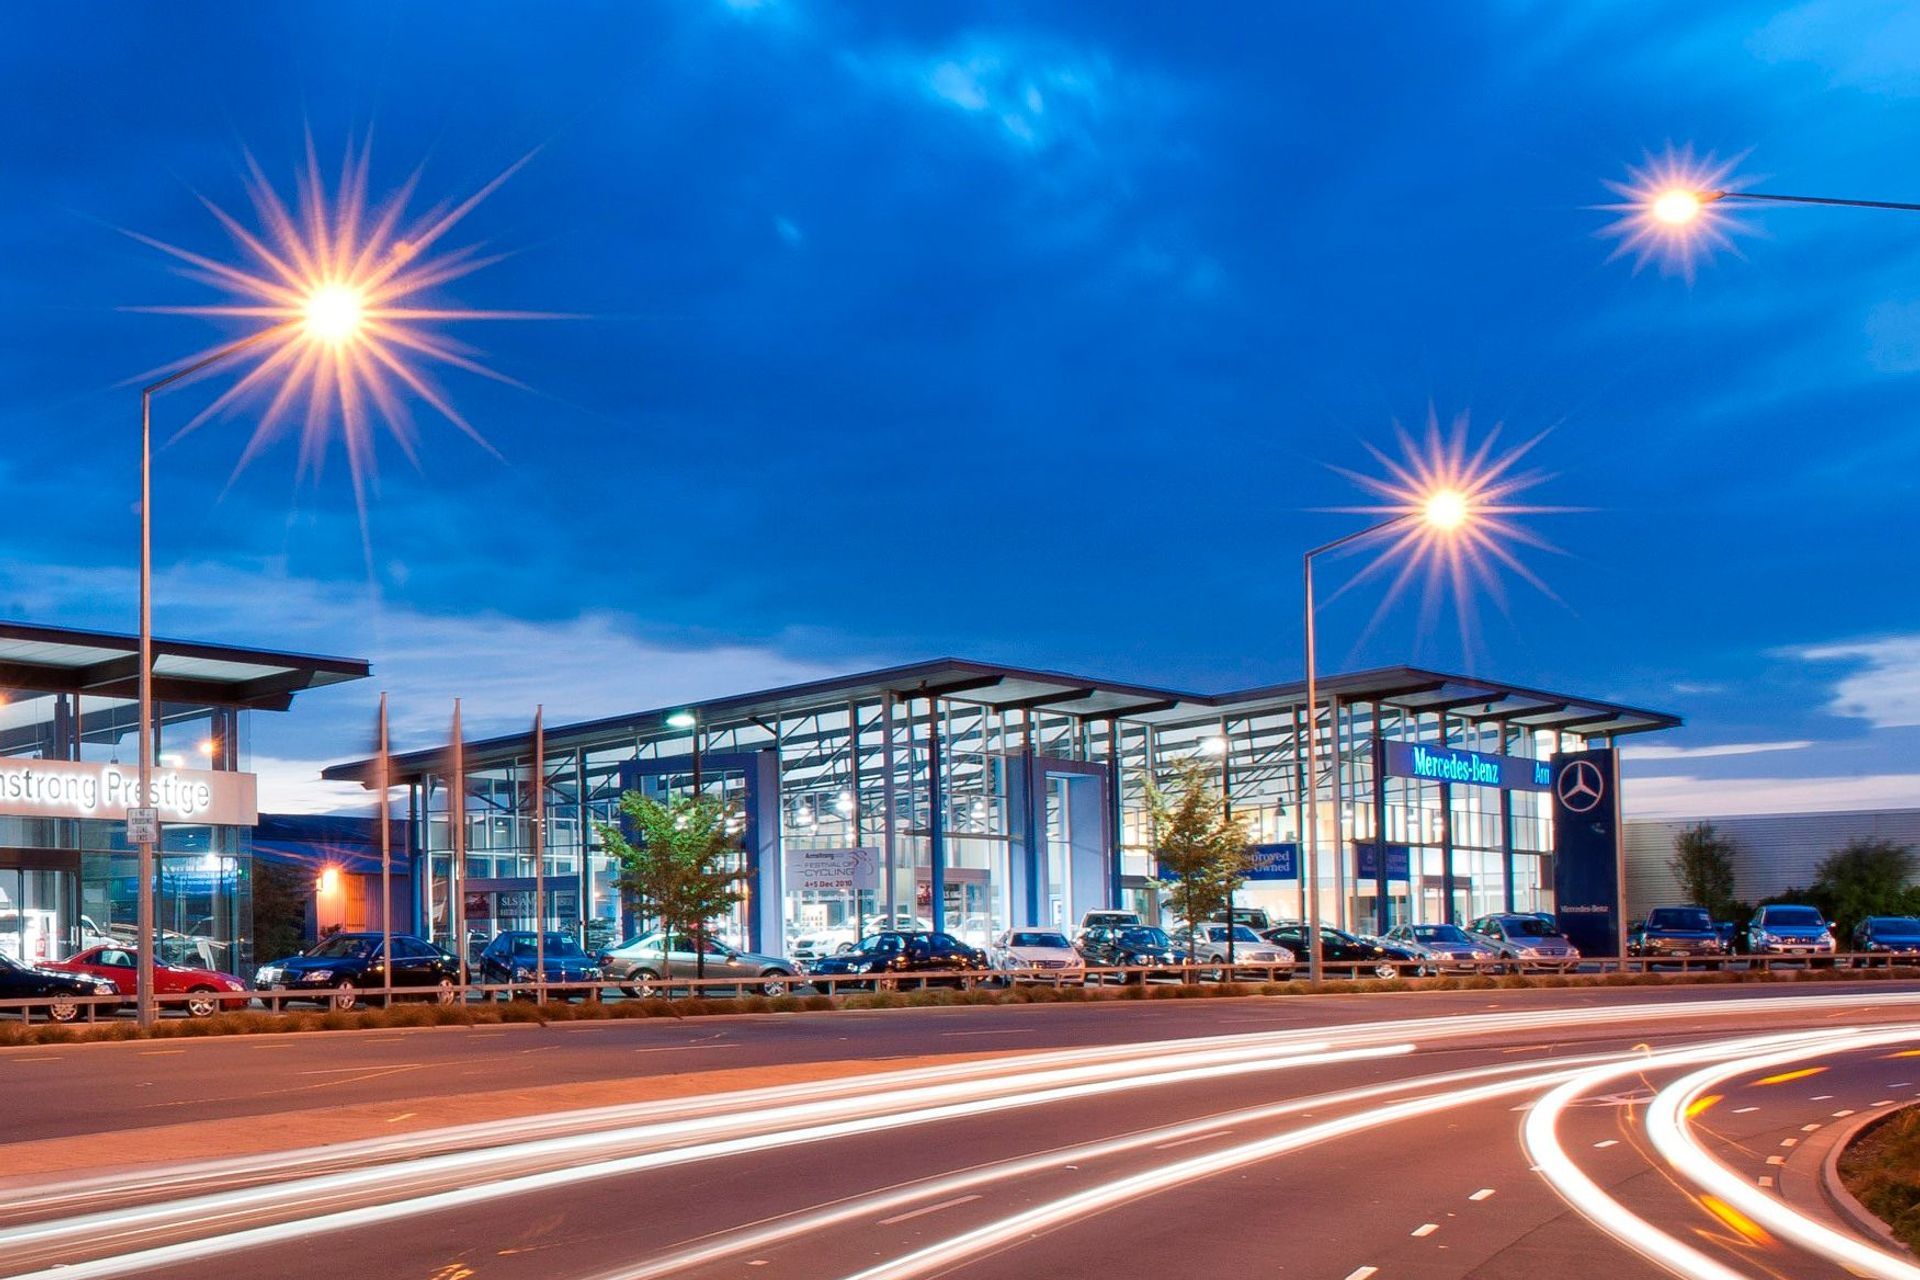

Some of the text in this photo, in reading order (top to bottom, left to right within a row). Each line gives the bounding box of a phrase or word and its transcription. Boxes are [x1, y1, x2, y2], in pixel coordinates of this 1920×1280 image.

[1413, 747, 1498, 783] Mercedes-Benz
[0, 770, 210, 814] strong Prestige
[804, 868, 856, 877] CYCLING
[819, 880, 834, 888] Dec
[835, 879, 853, 887] 2010
